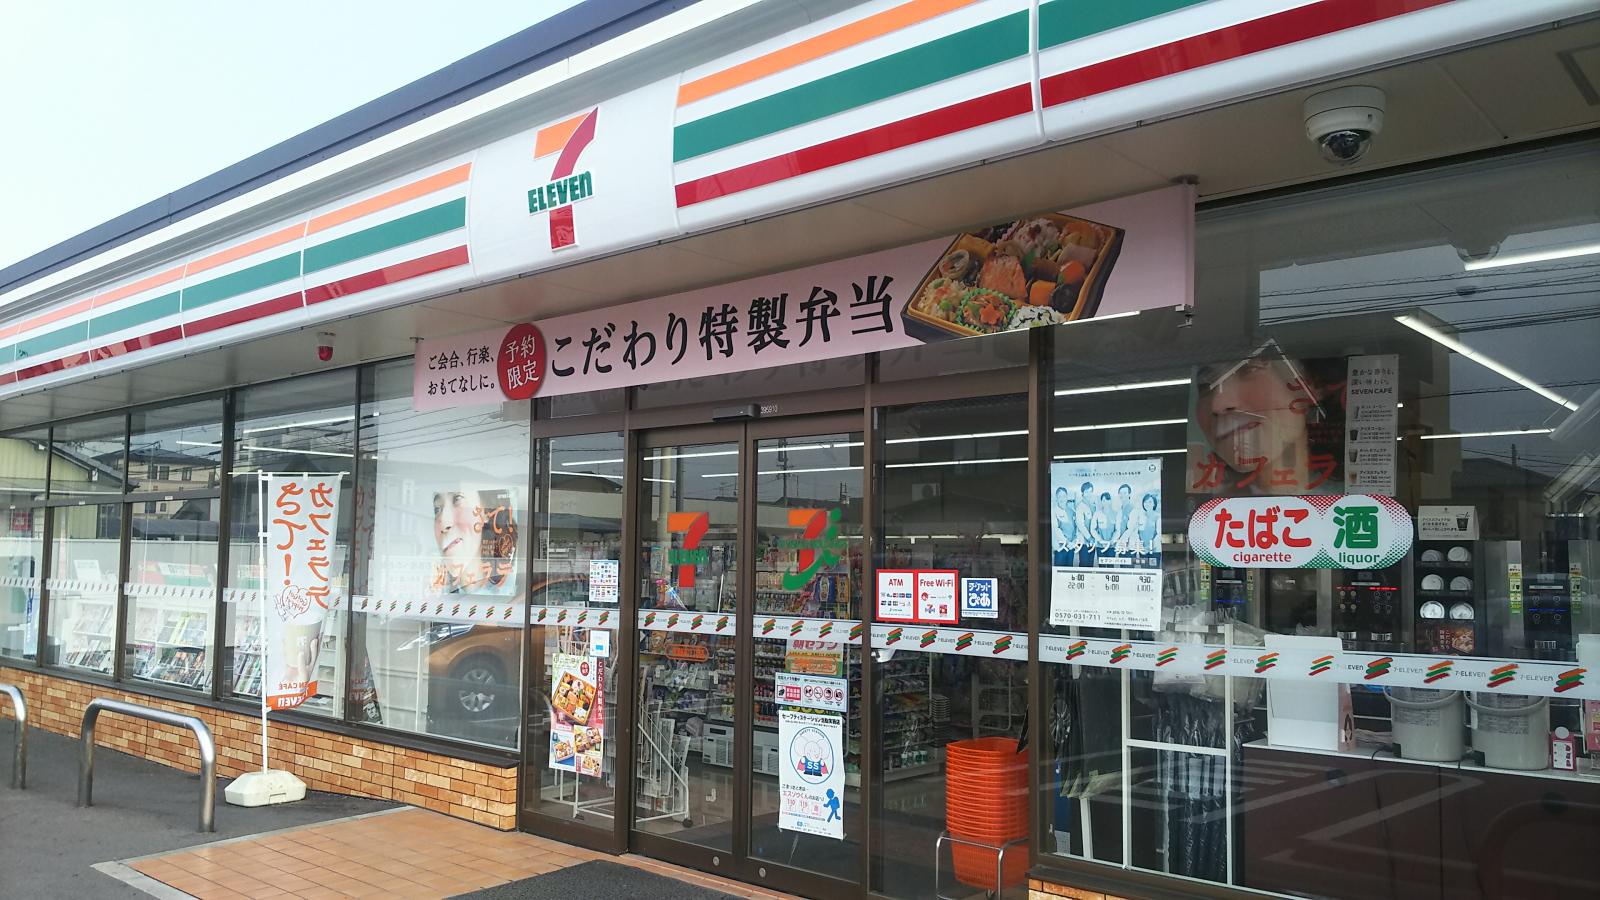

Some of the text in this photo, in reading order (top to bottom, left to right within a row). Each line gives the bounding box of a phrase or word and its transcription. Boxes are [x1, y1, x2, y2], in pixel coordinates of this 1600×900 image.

[551, 275, 894, 377] こだわり特製弁当
[505, 334, 536, 363] 予約
[428, 345, 494, 371] ご会合、行楽、
[507, 359, 540, 390] 限定
[427, 374, 495, 396] おもてなしに。
[1214, 505, 1312, 549] たばこ
[1333, 506, 1379, 549] 酒
[1233, 552, 1292, 564] cigarette
[1338, 552, 1380, 564] liquor
[888, 578, 904, 586] ATM
[920, 579, 953, 587] Free Wi-Fi
[968, 582, 991, 592] チケット
[968, 593, 991, 607] ぴあ
[807, 761, 819, 770] SS
